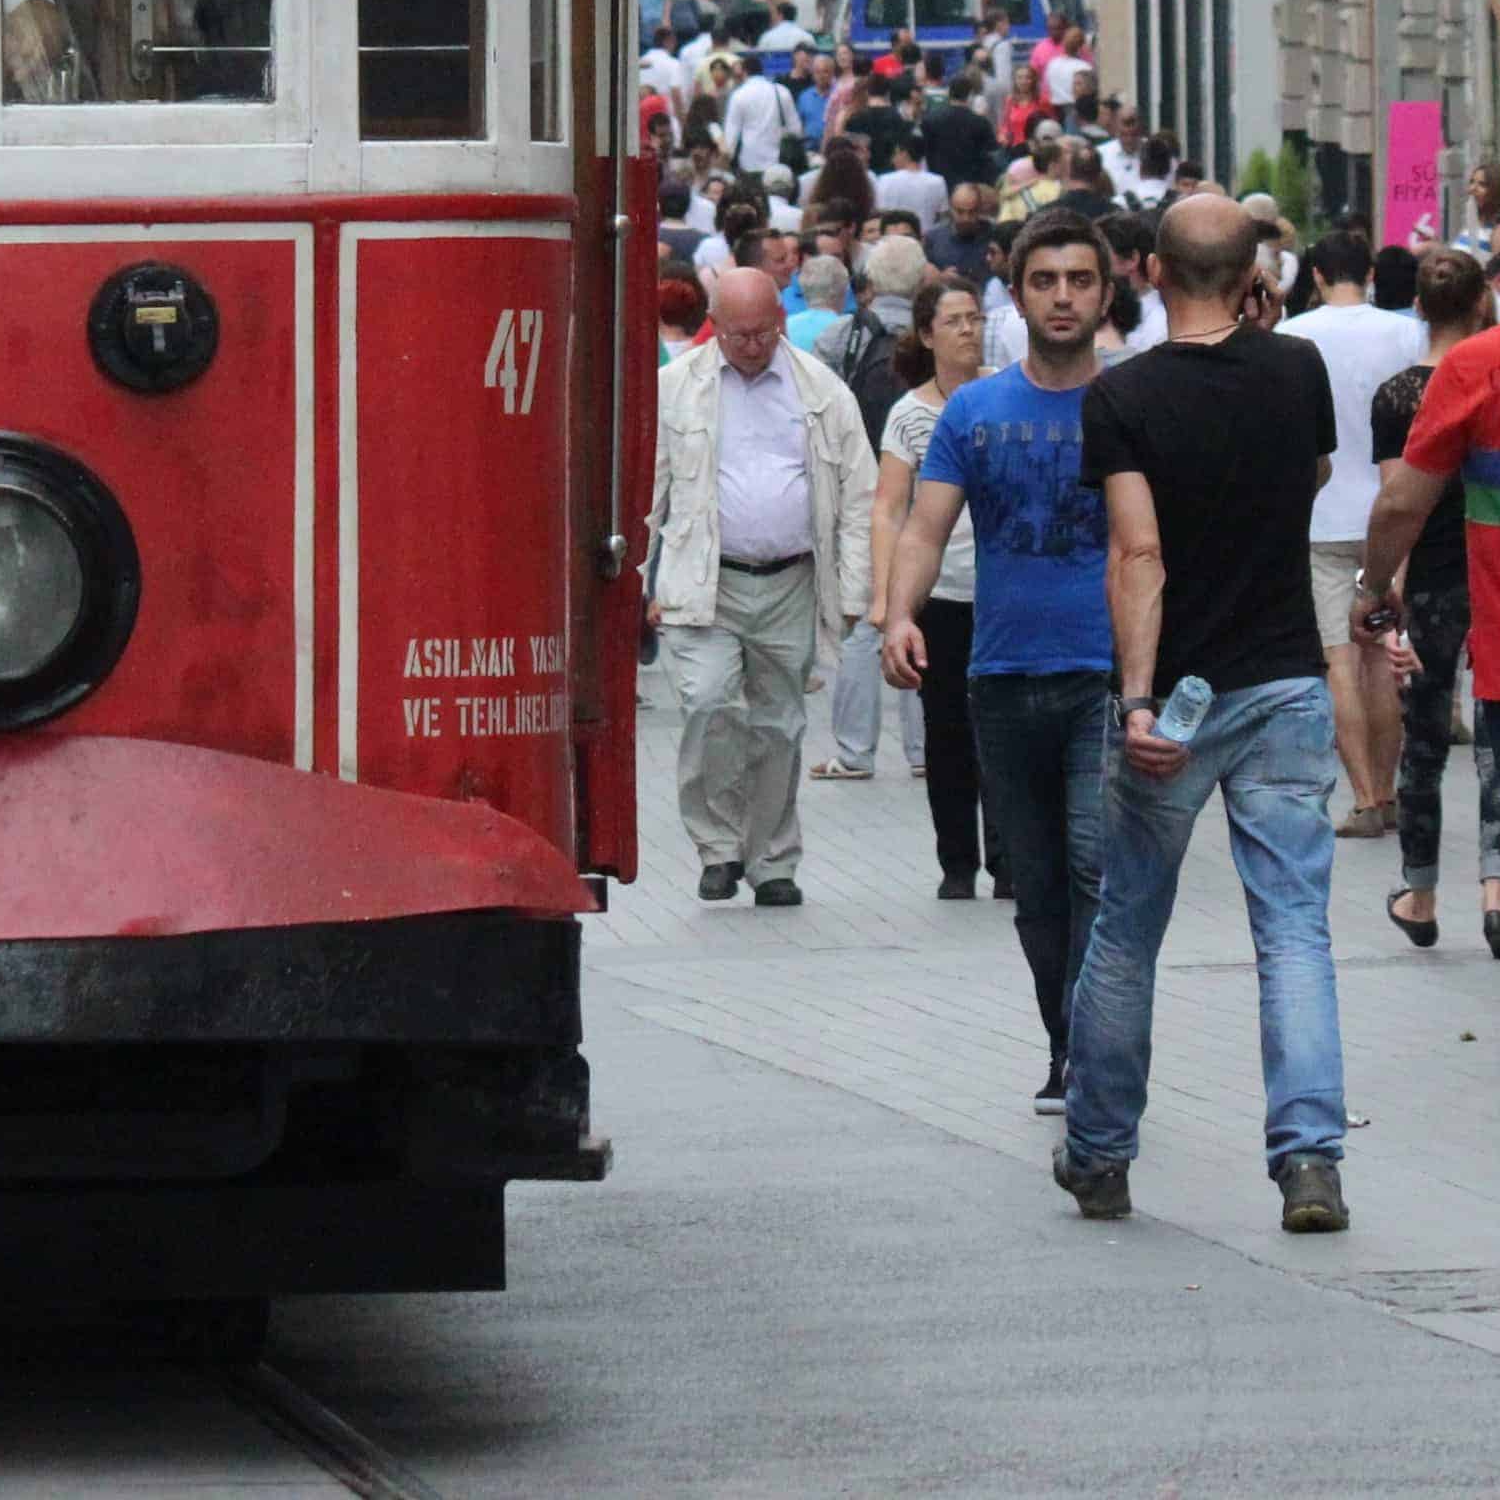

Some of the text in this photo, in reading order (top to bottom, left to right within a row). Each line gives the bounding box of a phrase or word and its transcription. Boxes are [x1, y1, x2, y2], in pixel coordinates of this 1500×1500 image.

[484, 308, 543, 415] 47
[403, 638, 516, 678] ASILMAK
[403, 698, 442, 737] VE
